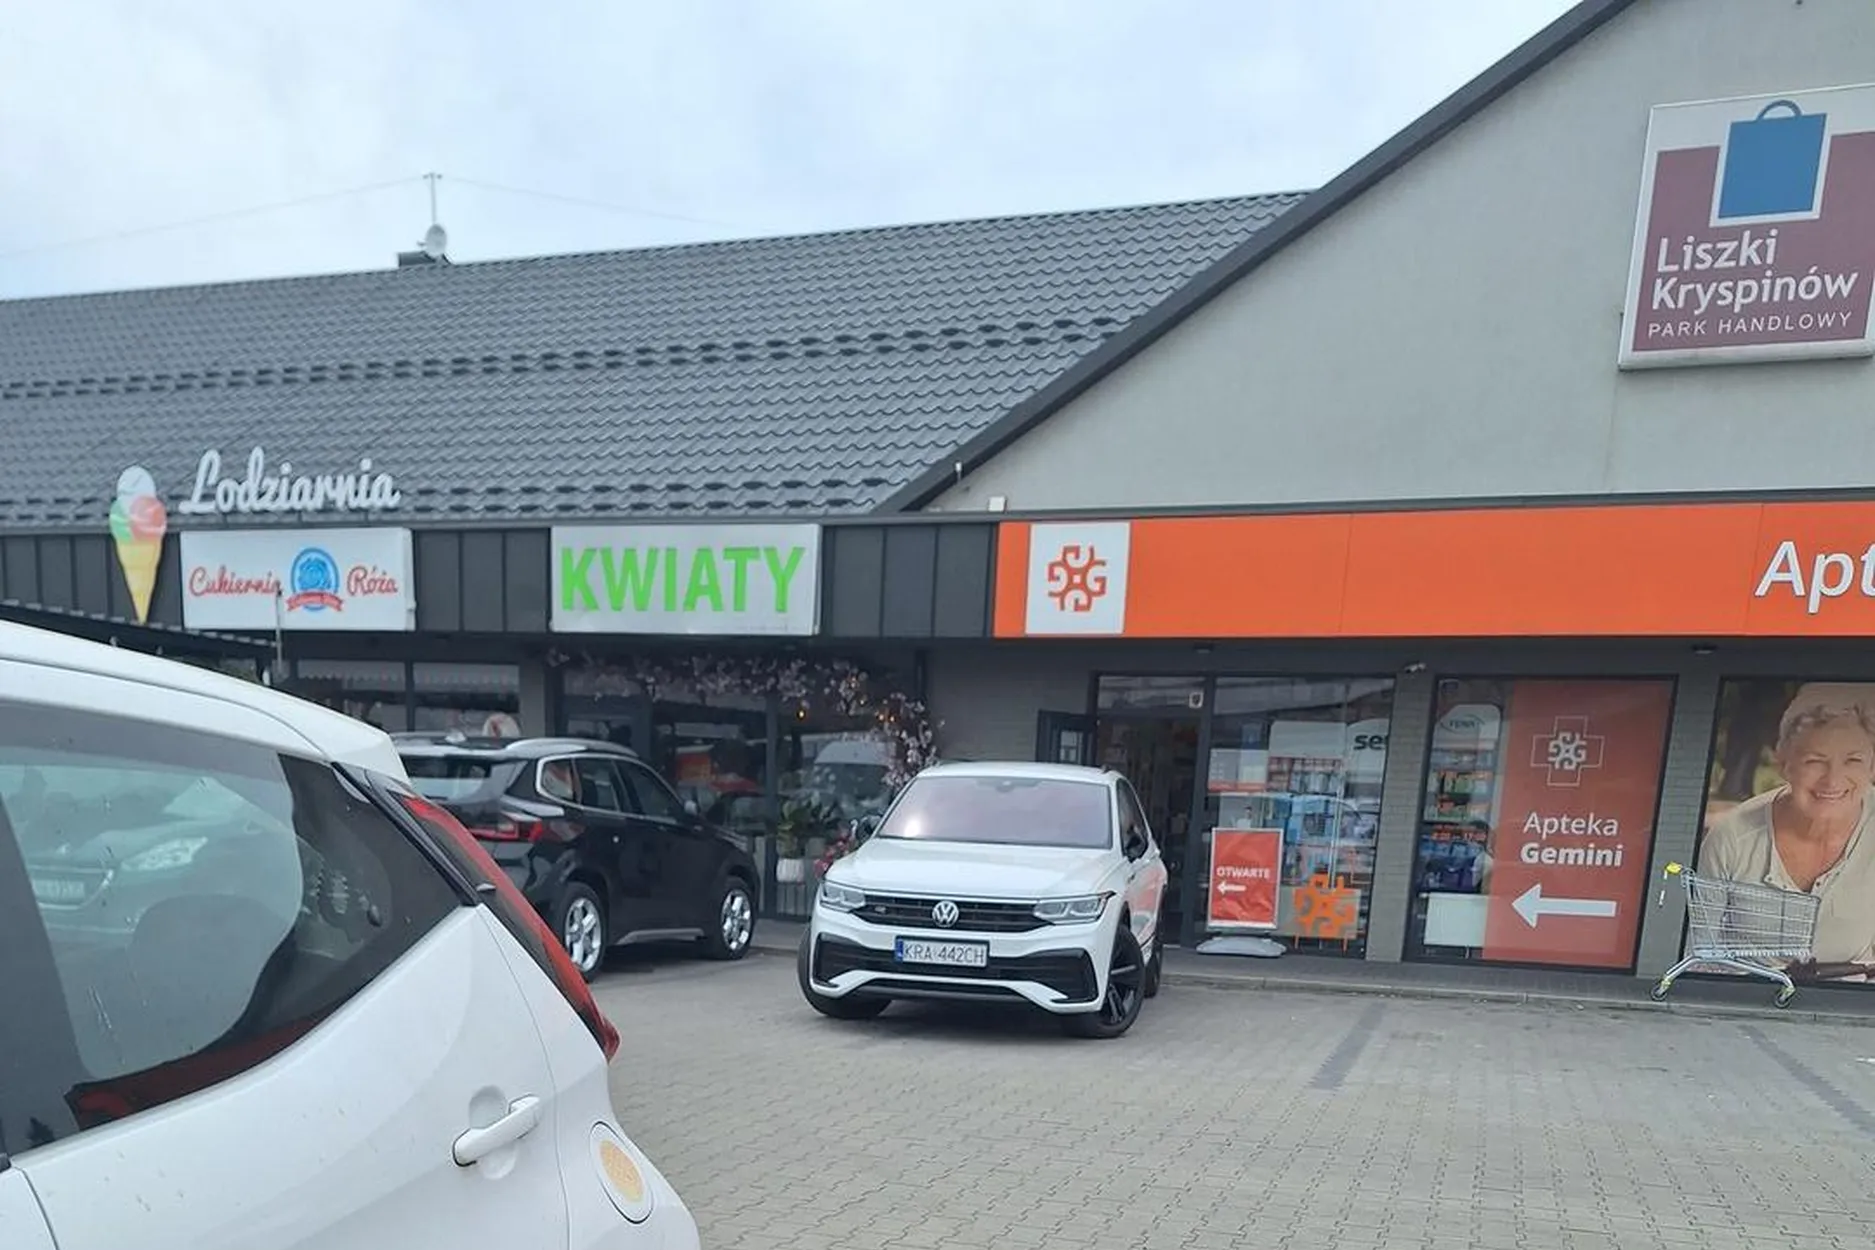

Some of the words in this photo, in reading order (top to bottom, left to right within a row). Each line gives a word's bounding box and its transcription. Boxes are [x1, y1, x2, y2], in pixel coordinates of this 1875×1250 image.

[1657, 228, 1779, 273] Liszki
[1652, 266, 1859, 316] Kryspinów
[1648, 320, 1708, 339] PARK
[1718, 311, 1853, 334] HANDLOWY
[178, 446, 401, 514] Lodziarnia
[189, 564, 283, 597] Cukiernia
[561, 546, 806, 613] KWIATY
[1523, 812, 1619, 840] Apteka
[1520, 842, 1624, 867] Gemini
[1216, 865, 1271, 878] OTWARTE
